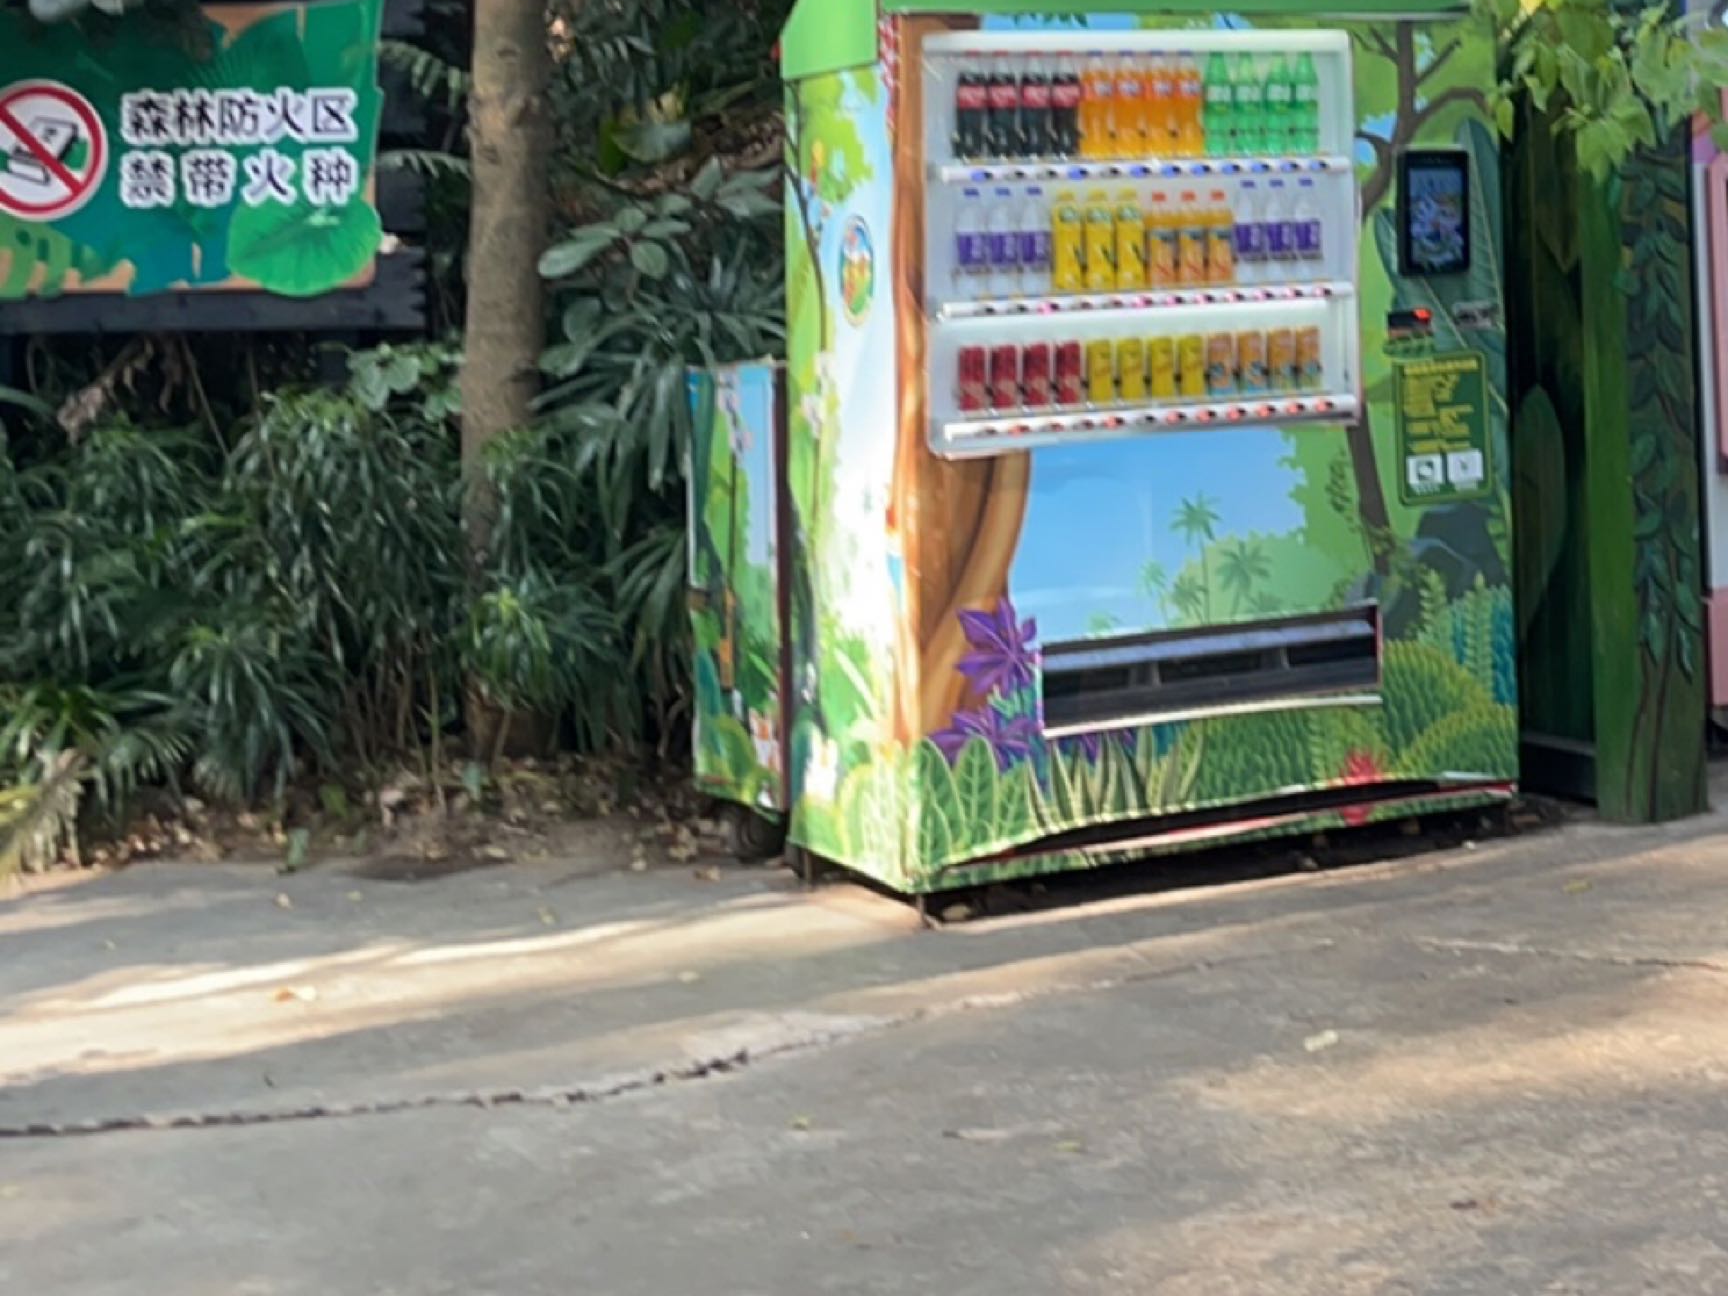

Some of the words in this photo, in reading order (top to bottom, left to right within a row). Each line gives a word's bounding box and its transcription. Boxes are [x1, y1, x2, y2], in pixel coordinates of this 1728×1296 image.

[122, 88, 357, 143] 森林防火区
[121, 150, 358, 207] 禁带火种
